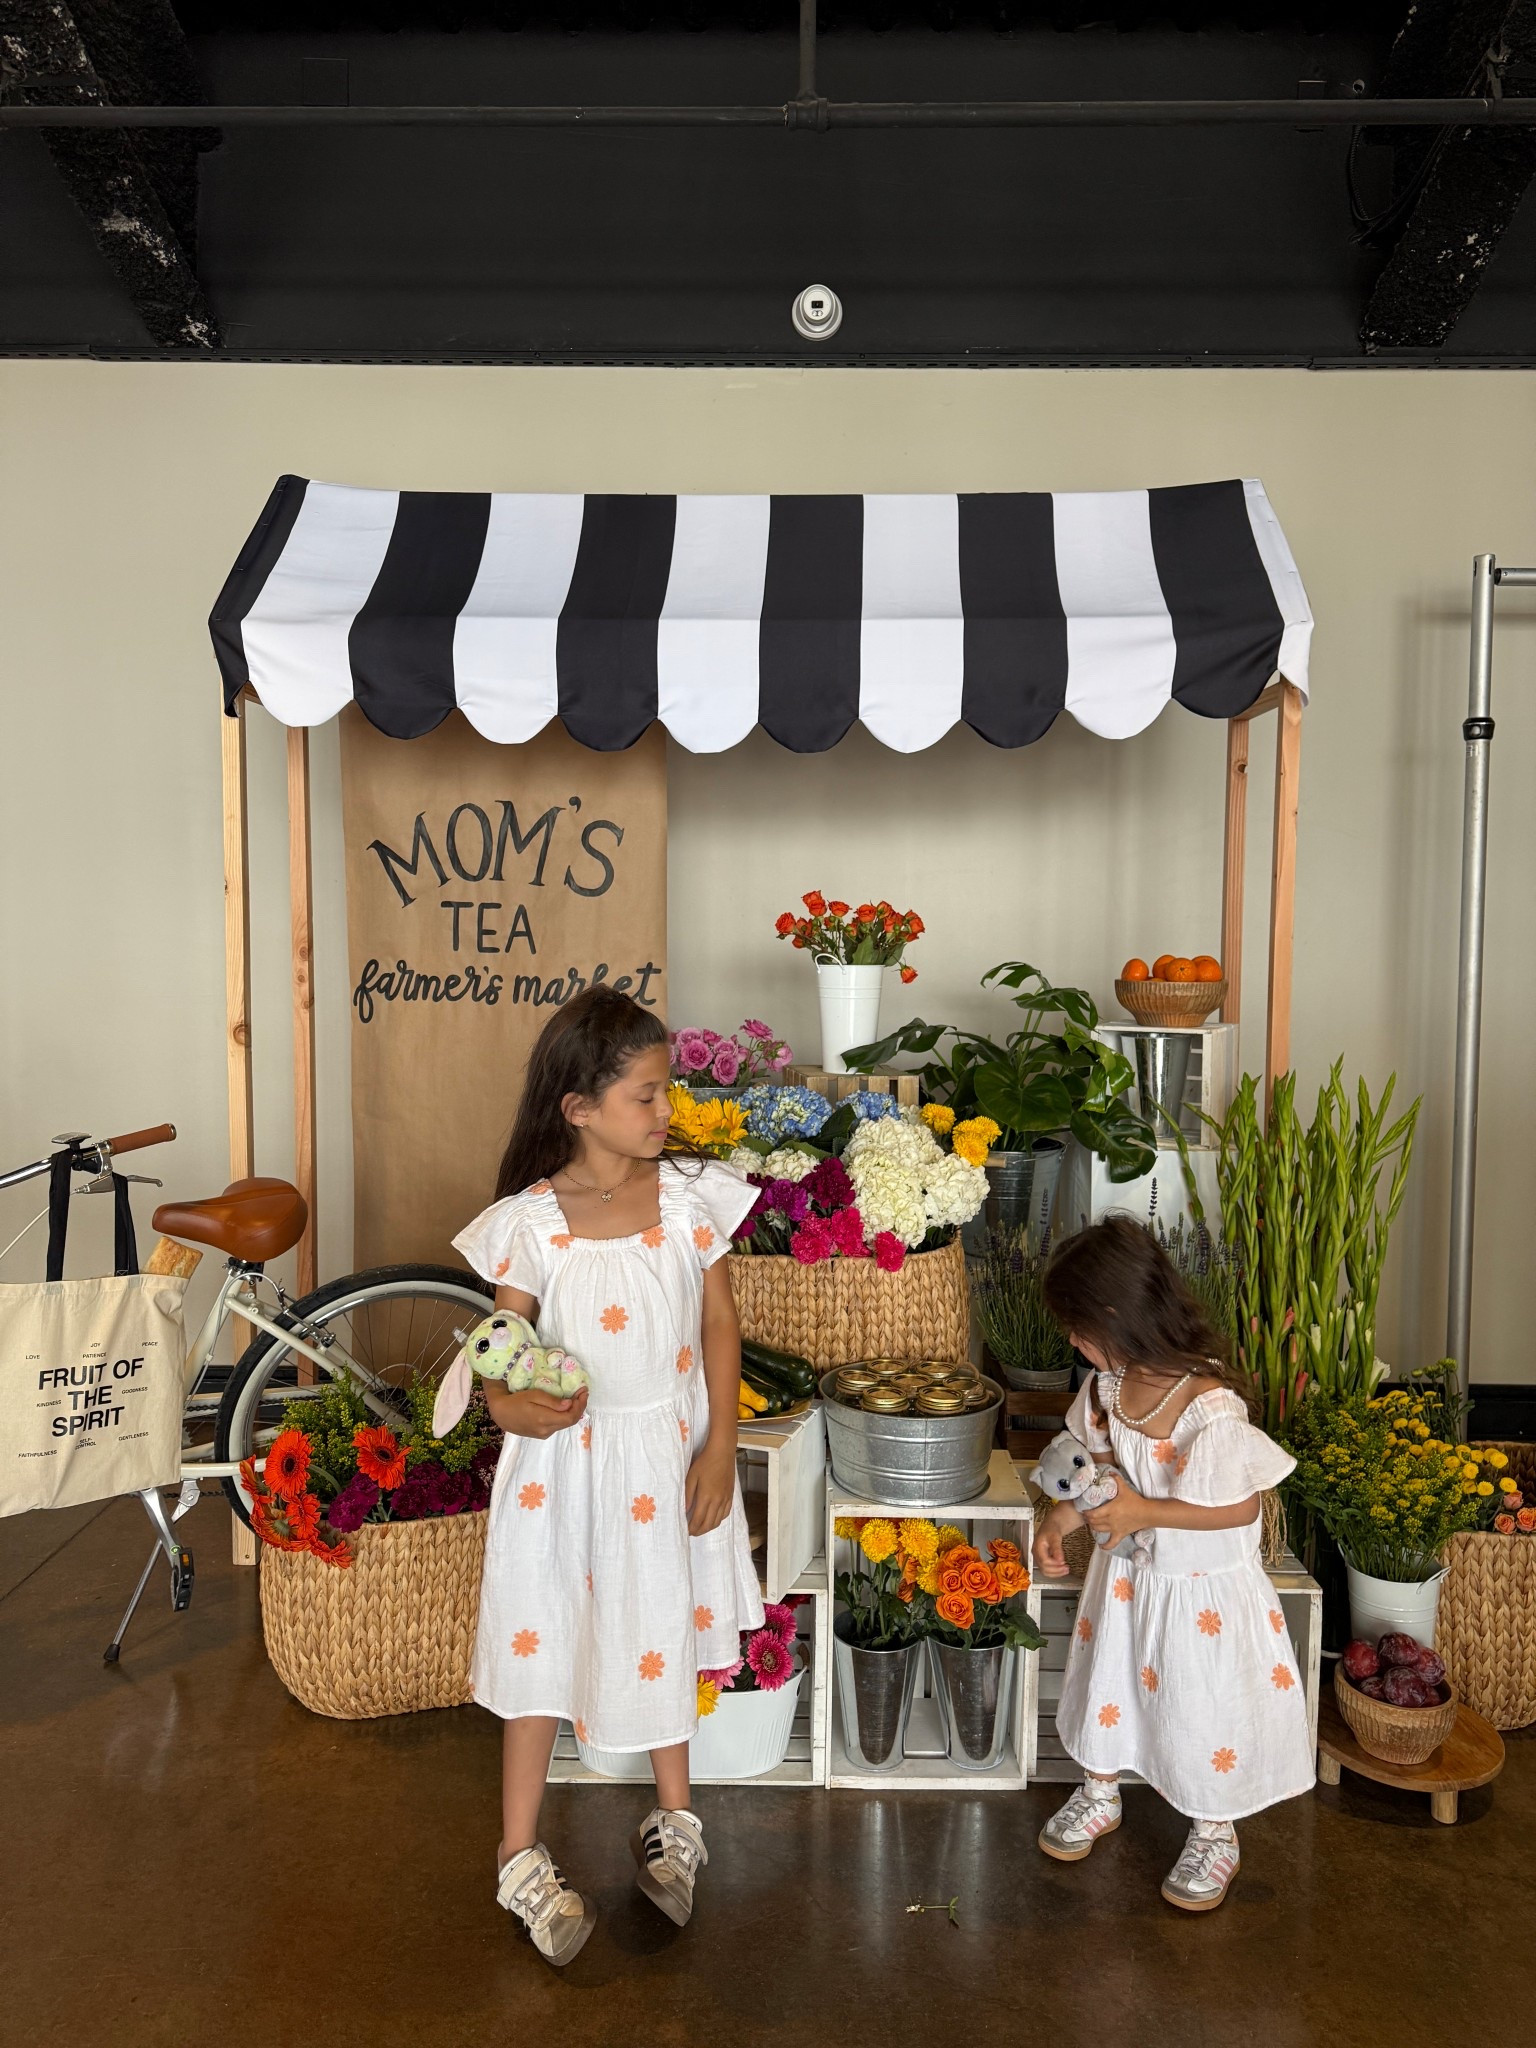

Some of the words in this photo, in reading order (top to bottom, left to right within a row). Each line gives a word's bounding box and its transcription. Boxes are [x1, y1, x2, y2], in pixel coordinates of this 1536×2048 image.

[366, 796, 625, 909] MOM'S
[440, 900, 537, 955] TEA
[353, 959, 503, 1024] farmer's
[38, 1362, 108, 1390] FRUIT
[112, 1357, 145, 1379] OF
[67, 1385, 113, 1410] THE
[51, 1405, 125, 1437] SPIRIT
